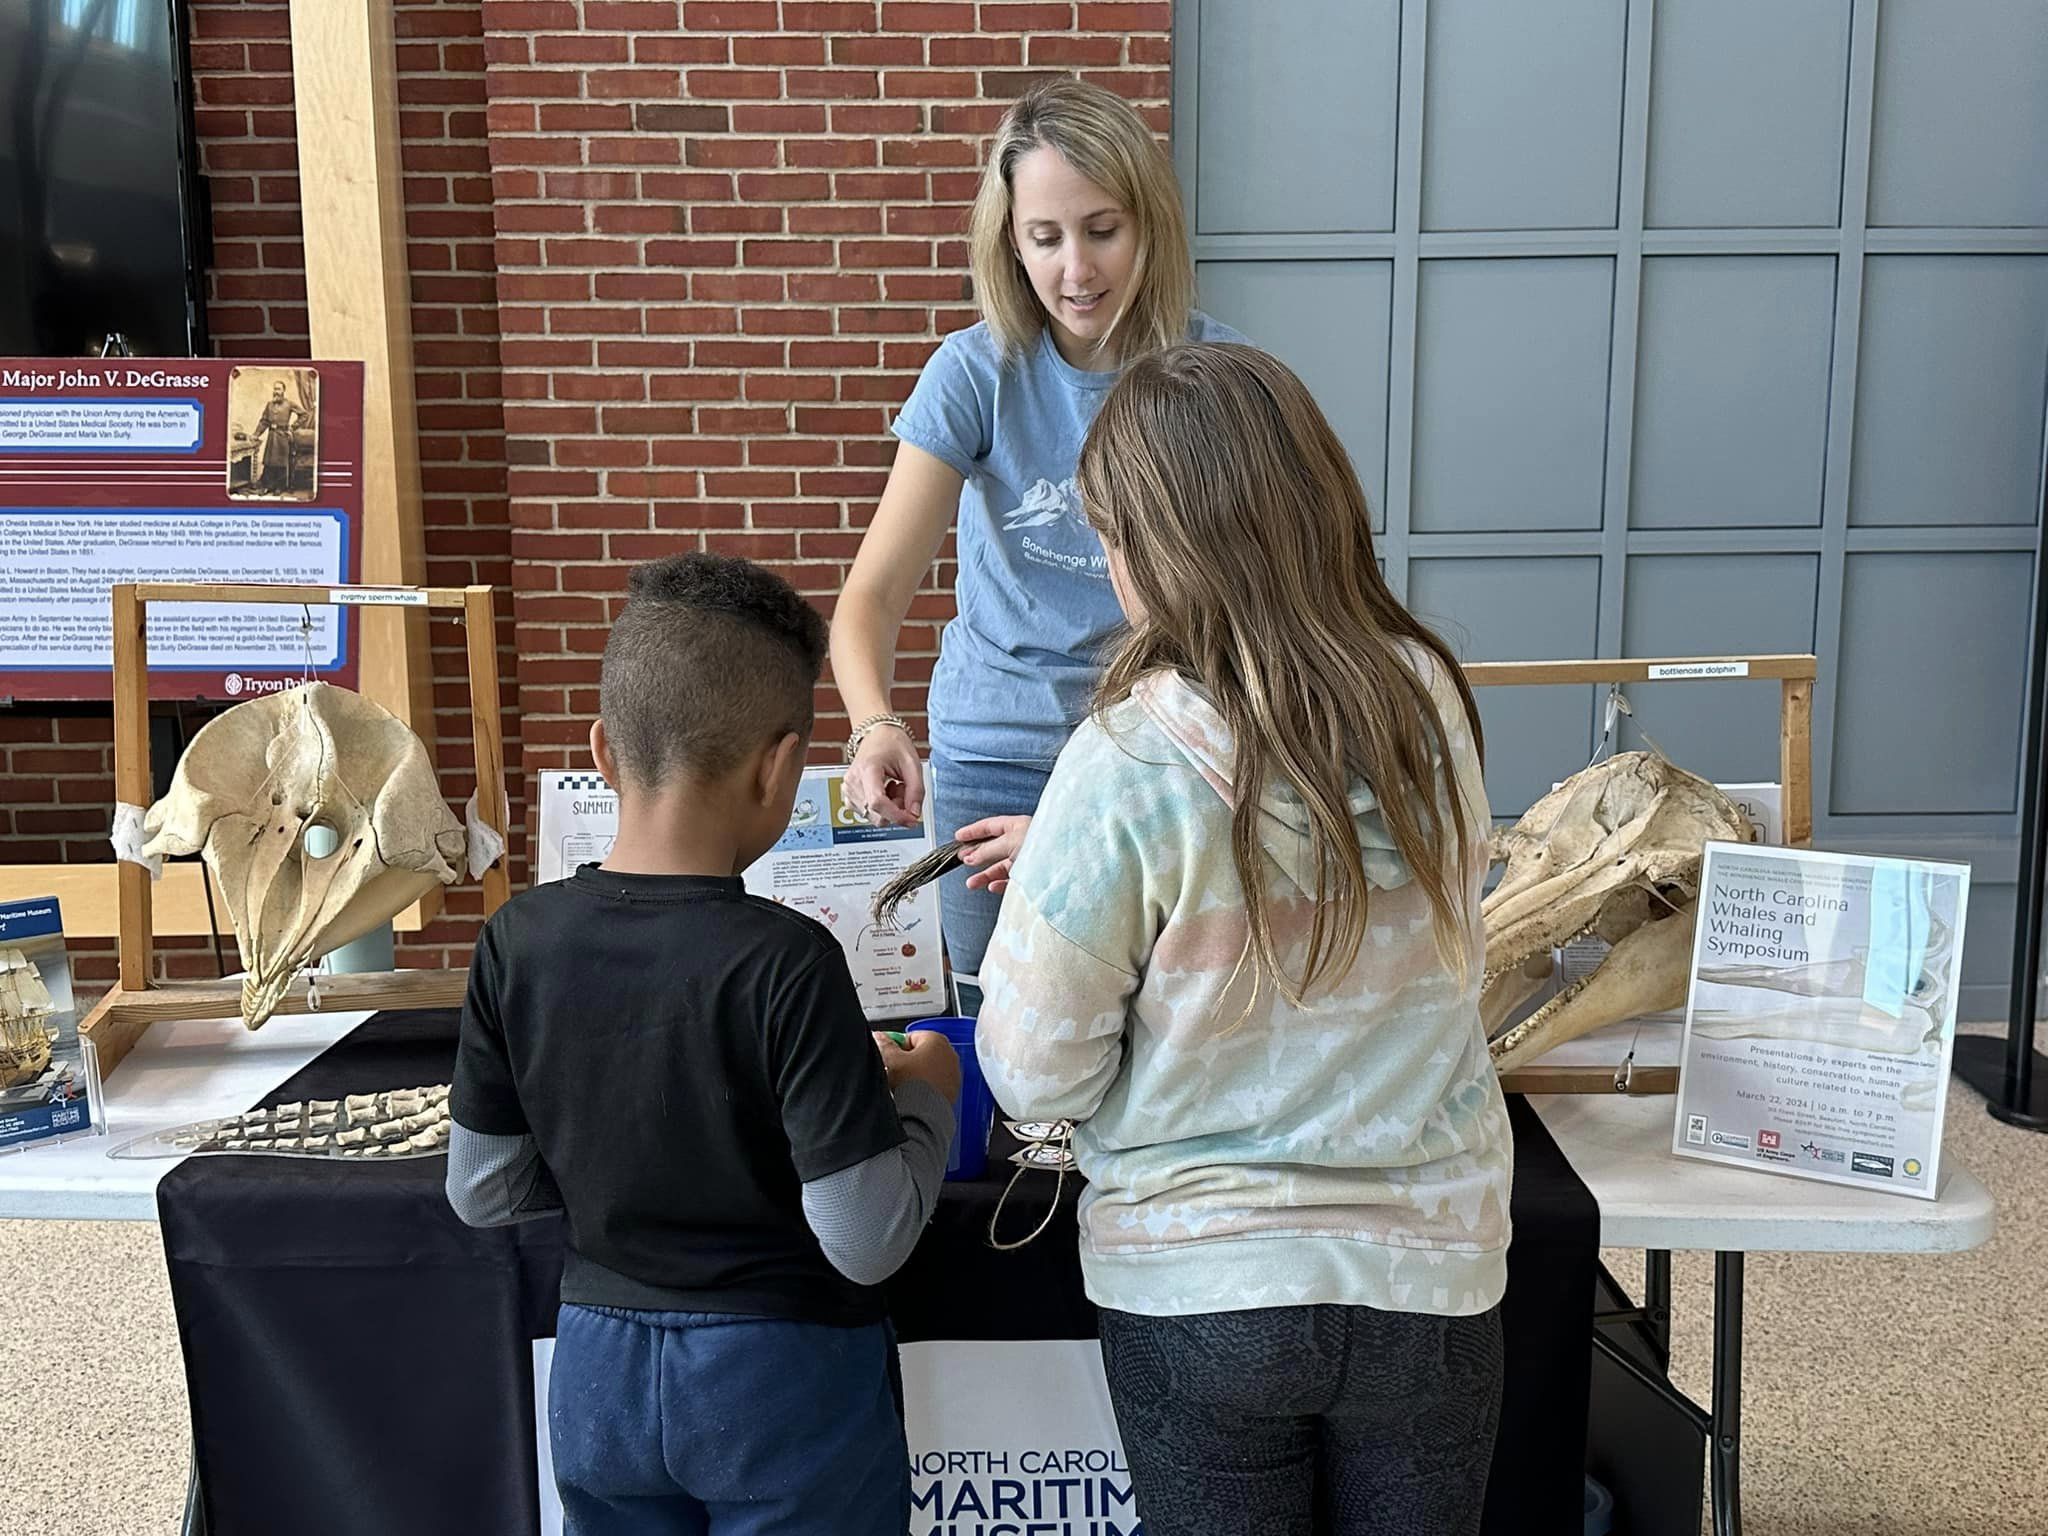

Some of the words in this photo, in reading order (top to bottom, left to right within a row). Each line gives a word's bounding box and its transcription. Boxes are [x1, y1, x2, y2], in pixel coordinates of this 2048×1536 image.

[2, 370, 55, 392] Major
[57, 369, 100, 390] John
[104, 371, 122, 387] V.
[126, 371, 209, 388] DeGrasse
[1022, 536, 1086, 567] Bonehenge
[1090, 555, 1108, 568] Wh
[340, 593, 366, 602] pygmy
[368, 594, 392, 602] sperm
[1660, 665, 1703, 676] bottlenose
[1706, 664, 1736, 676] dolphin
[243, 678, 283, 692] Tryon
[1714, 884, 1765, 903] North
[1772, 890, 1849, 912] Carolina
[27, 908, 52, 916] Museum
[1712, 901, 1777, 922] Whales
[1783, 912, 1816, 927] and
[1710, 918, 1783, 944] Whaling
[1707, 936, 1809, 962] Symposium
[1701, 1052, 1760, 1067] environment,
[1763, 1061, 1798, 1073] history,
[1801, 1068, 1864, 1083] conservation,
[1868, 1077, 1900, 1088] human
[1750, 1044, 1813, 1062] Presentations
[1817, 1055, 1827, 1065] by
[1831, 1059, 1866, 1070] experts
[1886, 1065, 1902, 1074] the
[1776, 1077, 1809, 1087] culture
[1812, 1082, 1846, 1093] related
[1863, 1090, 1898, 1101] whales.
[1736, 1090, 1766, 1102] March
[1786, 1097, 1807, 1108] 2024
[1854, 1108, 1863, 1117] to
[910, 1451, 1008, 1477] NORTH
[1019, 1450, 1129, 1474] CAROL
[912, 1478, 1134, 1520] MARITIM
